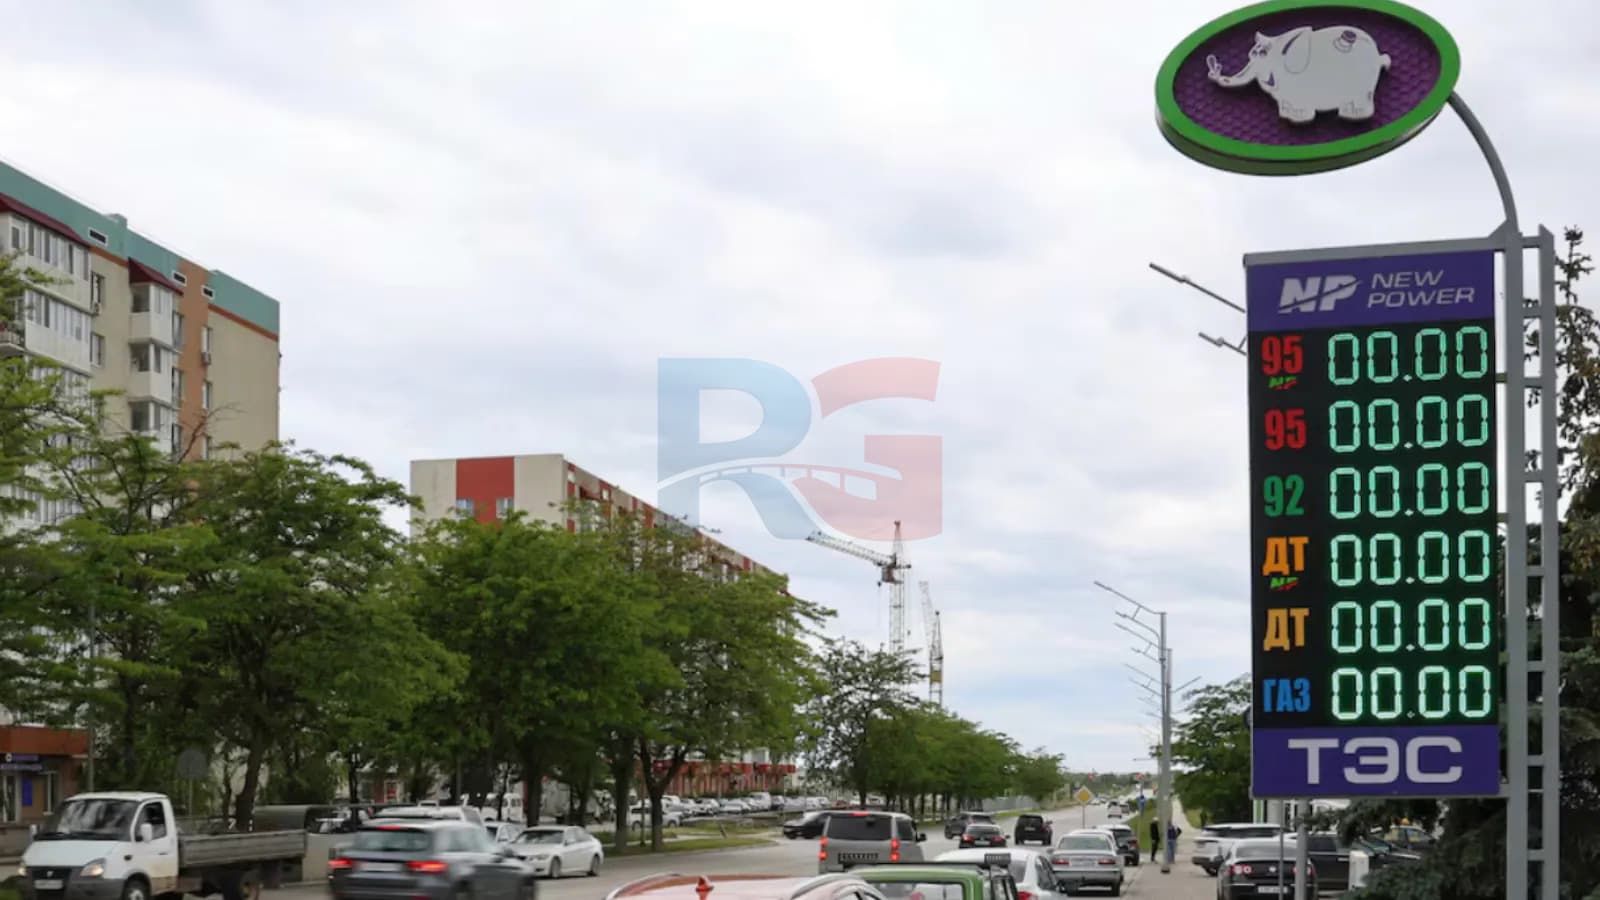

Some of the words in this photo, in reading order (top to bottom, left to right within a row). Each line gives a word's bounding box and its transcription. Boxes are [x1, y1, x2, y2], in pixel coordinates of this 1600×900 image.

[1277, 275, 1362, 314] NP
[1367, 287, 1475, 308] POWER
[1371, 270, 1444, 289] NEW
[1261, 335, 1304, 375] 95
[1328, 326, 1488, 385] 00.00
[1264, 409, 1307, 450] 95
[1329, 394, 1488, 453] 00.00
[1263, 474, 1305, 517] 92
[1329, 461, 1489, 520] 00.00
[1262, 536, 1309, 576] ДТ
[1330, 530, 1490, 587] 00.00
[1263, 608, 1310, 651] ДТ
[1331, 598, 1490, 654] 00.00
[1262, 677, 1311, 713] ГАЗ
[1332, 665, 1491, 720] 00.00
[1288, 736, 1463, 784] ТЭС
